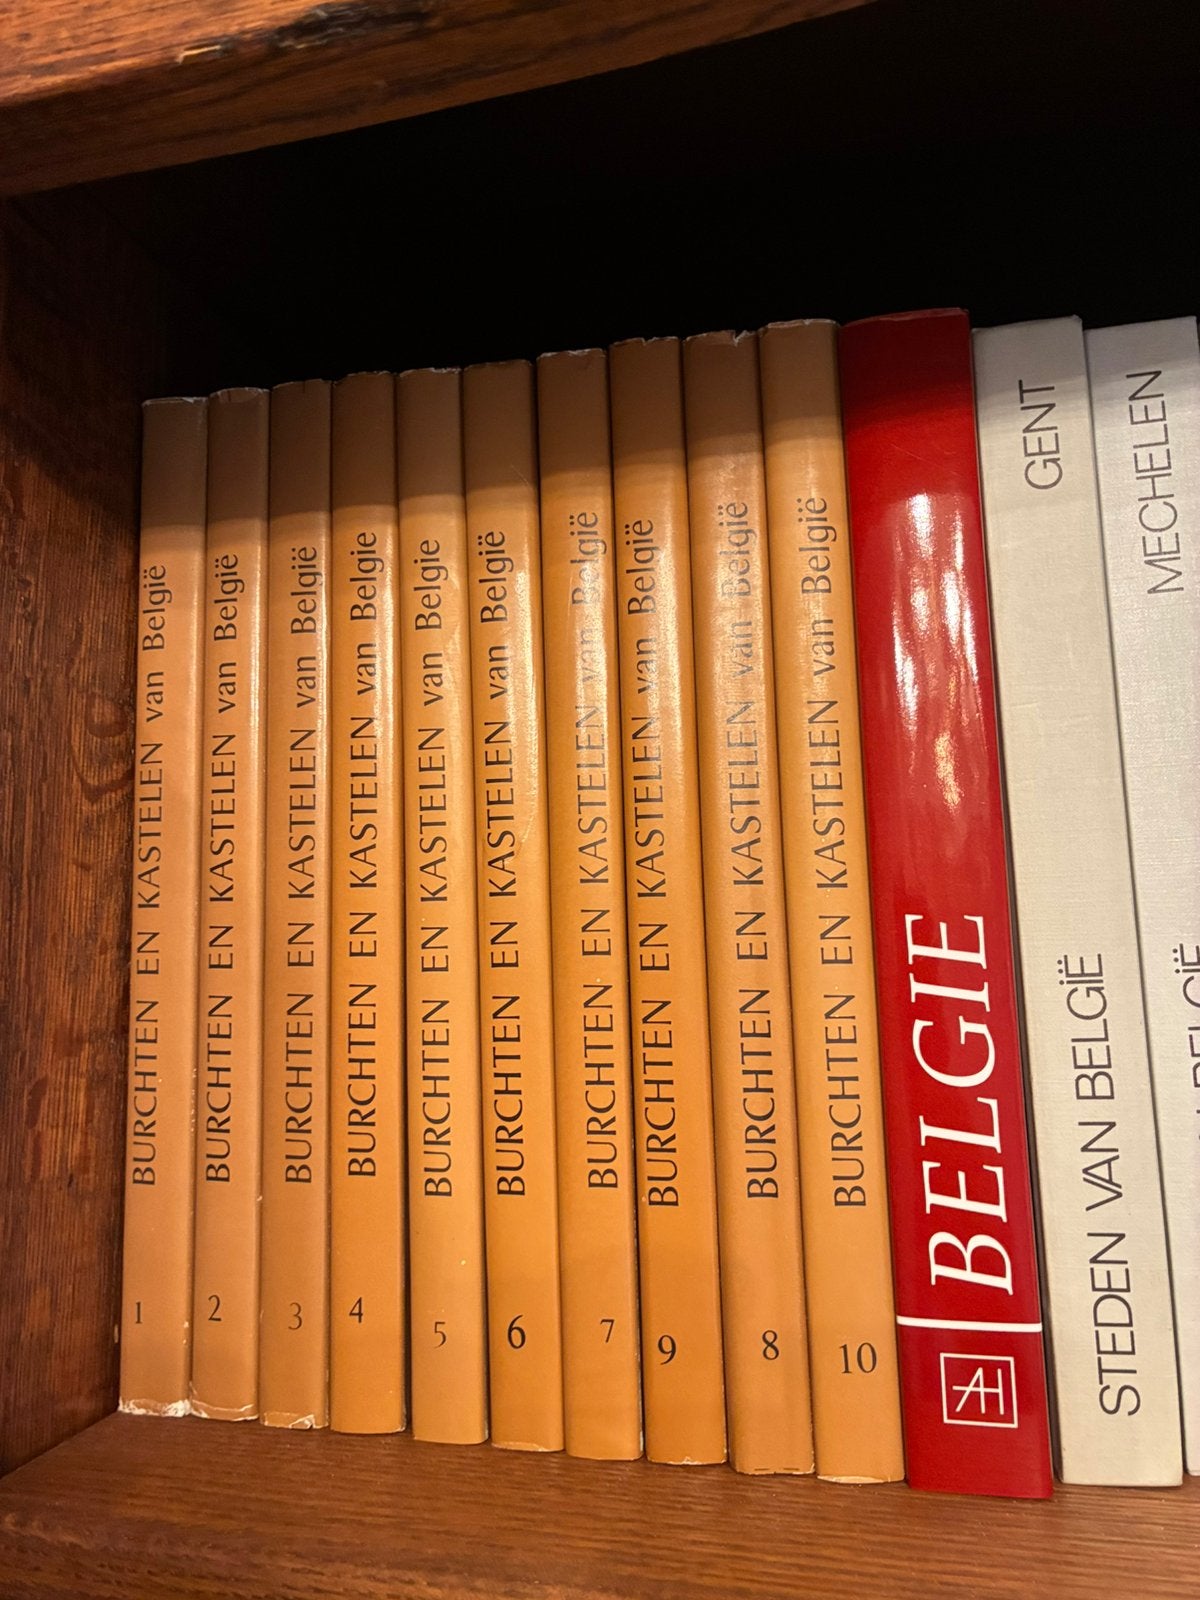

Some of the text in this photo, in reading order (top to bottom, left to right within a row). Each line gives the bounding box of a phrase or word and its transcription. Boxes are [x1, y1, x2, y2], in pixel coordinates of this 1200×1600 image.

[1018, 379, 1063, 489] GENT
[1126, 370, 1184, 594] MECHELEN
[569, 511, 607, 605] België
[356, 642, 377, 696] van
[423, 652, 444, 706] van
[349, 717, 378, 888] KASTELEN
[418, 727, 448, 902] KASTELEN
[575, 705, 609, 884] KASTELEN
[132, 565, 172, 1186] BURCHTEN EN KASTELEN van België
[205, 554, 245, 1182] BURCHTEN EN KASTELEN van België
[285, 546, 323, 1183] BURCHTEN EN KASTELEN van België
[478, 531, 526, 1196] BURCHTEN EN KASTELEN van België
[624, 519, 679, 1207] BURCHTEN EN KASTELEN van België
[717, 501, 779, 1199] BURCHTEN EN KASTELEN van België
[797, 497, 866, 1207] BURCHTEN EN KASTELEN van België
[349, 912, 378, 957] EN
[420, 926, 449, 972] EN
[580, 909, 612, 956] EN
[347, 984, 377, 1177] BURCHTEN
[421, 1000, 452, 1197] BURCHTEN
[583, 984, 619, 1188] BURCHTEN
[904, 913, 1013, 1296] BELGIE
[1078, 1121, 1123, 1212] VAN
[134, 1301, 143, 1324] 1
[207, 1295, 222, 1322] 2
[287, 1302, 303, 1330] 3
[349, 1297, 364, 1324] 4
[433, 1321, 448, 1349] 5
[507, 1314, 527, 1350] 6
[600, 1319, 615, 1344] 7
[657, 1334, 677, 1366] 9
[762, 1330, 780, 1361] 8
[839, 1342, 877, 1375] 10
[1087, 1232, 1141, 1416] STEDEN
